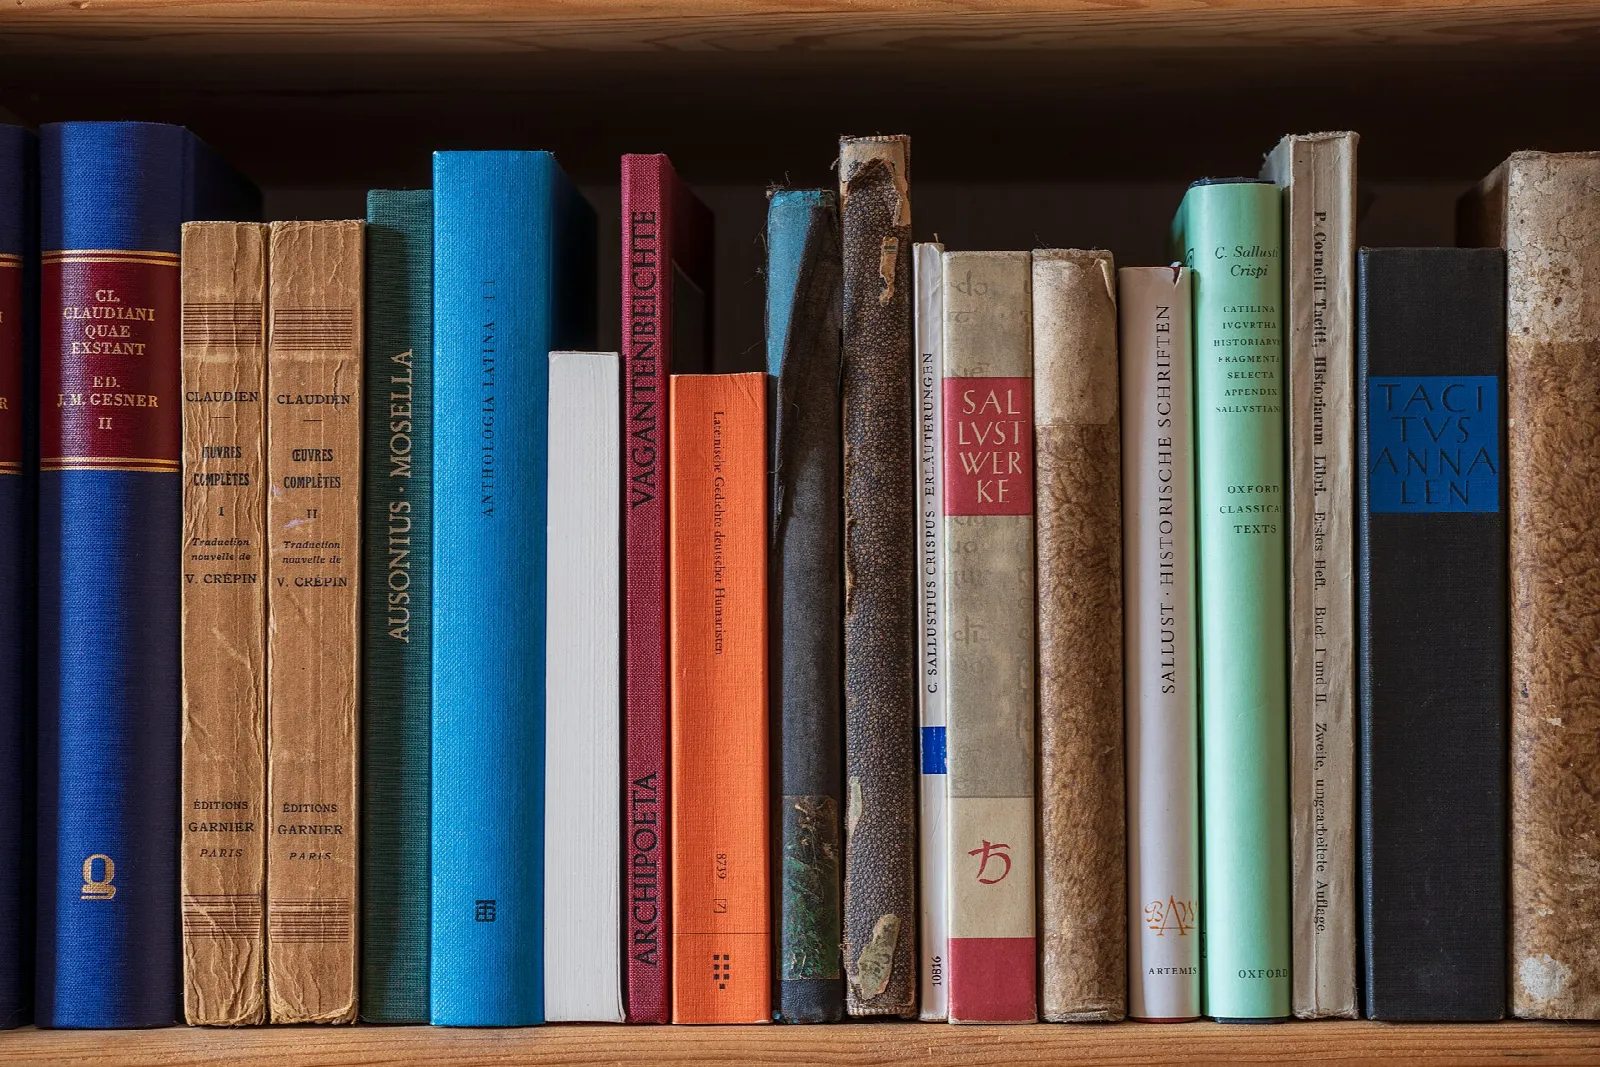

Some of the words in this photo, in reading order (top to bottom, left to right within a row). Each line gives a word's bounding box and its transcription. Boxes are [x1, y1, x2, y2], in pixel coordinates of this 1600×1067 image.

[1313, 211, 1327, 226] P.
[1215, 246, 1227, 259] C.
[1313, 232, 1327, 290] Cornelii
[1231, 264, 1268, 278] Crispi
[95, 290, 120, 302] CL.
[63, 307, 155, 322] CLAUDIANI
[1223, 305, 1275, 313] CATILINA
[85, 325, 131, 339] QUAE
[1223, 321, 1277, 329] IVGVRTHA
[72, 342, 146, 356] EXSTANT
[483, 322, 495, 387] LATINA
[632, 211, 657, 510] VAGANTENBEICHTE
[1156, 305, 1171, 428] SCHRIFTEN
[92, 376, 121, 388] ED.
[1225, 388, 1278, 396] APPENDIX
[90, 394, 159, 408] GESNER
[185, 392, 258, 402] CLAUDIEN
[277, 394, 350, 404] CLAUDIEN
[962, 389, 1021, 415] SAL
[1313, 357, 1327, 446] Historiarum
[1376, 384, 1482, 413] TACI
[98, 417, 113, 430] II
[390, 349, 413, 478] MOSELLA
[923, 353, 935, 496] ERLÄUTERUNGEN
[713, 411, 726, 473] Lateinische
[958, 420, 1026, 446] LVST
[1391, 416, 1471, 444] TVS
[292, 449, 333, 461] ŒUVRES
[482, 396, 495, 518] ANTHOLOGIA
[959, 451, 1023, 475] WER
[1370, 446, 1497, 476] ANNA
[193, 471, 250, 486] COMPLÈTES
[283, 473, 341, 488] COMPLÈTES
[1313, 456, 1327, 497] Libri.
[976, 479, 1010, 503] KE
[1228, 485, 1280, 493] OXFORD
[1400, 478, 1470, 506] LEN
[219, 507, 224, 516] I
[307, 509, 318, 519] II
[714, 477, 726, 527] Gedichte
[1158, 437, 1173, 586] HISTORISCHE
[1234, 525, 1276, 534] TEXTS
[1314, 512, 1326, 551] Erstes
[192, 538, 250, 546] Traduction
[925, 510, 936, 576] CRISPUS
[714, 531, 726, 584] deutscher
[185, 574, 198, 584] V.
[203, 572, 257, 584] CRÉPIN
[277, 577, 289, 587] V.
[294, 575, 347, 587] CRÉPIN
[388, 501, 411, 643] AUSONIUS
[1314, 560, 1326, 591] Heft.
[714, 587, 726, 655] Humanisten
[926, 581, 937, 676] SALLUSTIUS
[1314, 607, 1326, 639] Buch
[1160, 602, 1175, 694] SALLUST
[1315, 661, 1327, 685] und
[928, 682, 938, 694] C.
[1315, 693, 1327, 707] II.
[1314, 723, 1327, 771] Zweite,
[193, 799, 248, 810] ÉDITIONS
[283, 802, 337, 812] ÉDITIONS
[188, 822, 254, 832] GARNIER
[278, 824, 343, 834] GARNIER
[1313, 779, 1328, 872] umgearbeitete
[200, 849, 243, 857] PARIS
[633, 771, 658, 966] ARCHIPOETA
[716, 853, 727, 879] 8739
[713, 898, 727, 913] [7]
[1313, 880, 1328, 935] Auflage.
[932, 955, 942, 986] 10816
[1148, 967, 1197, 975] ARTEMIS
[1238, 969, 1288, 978] OXFORD
